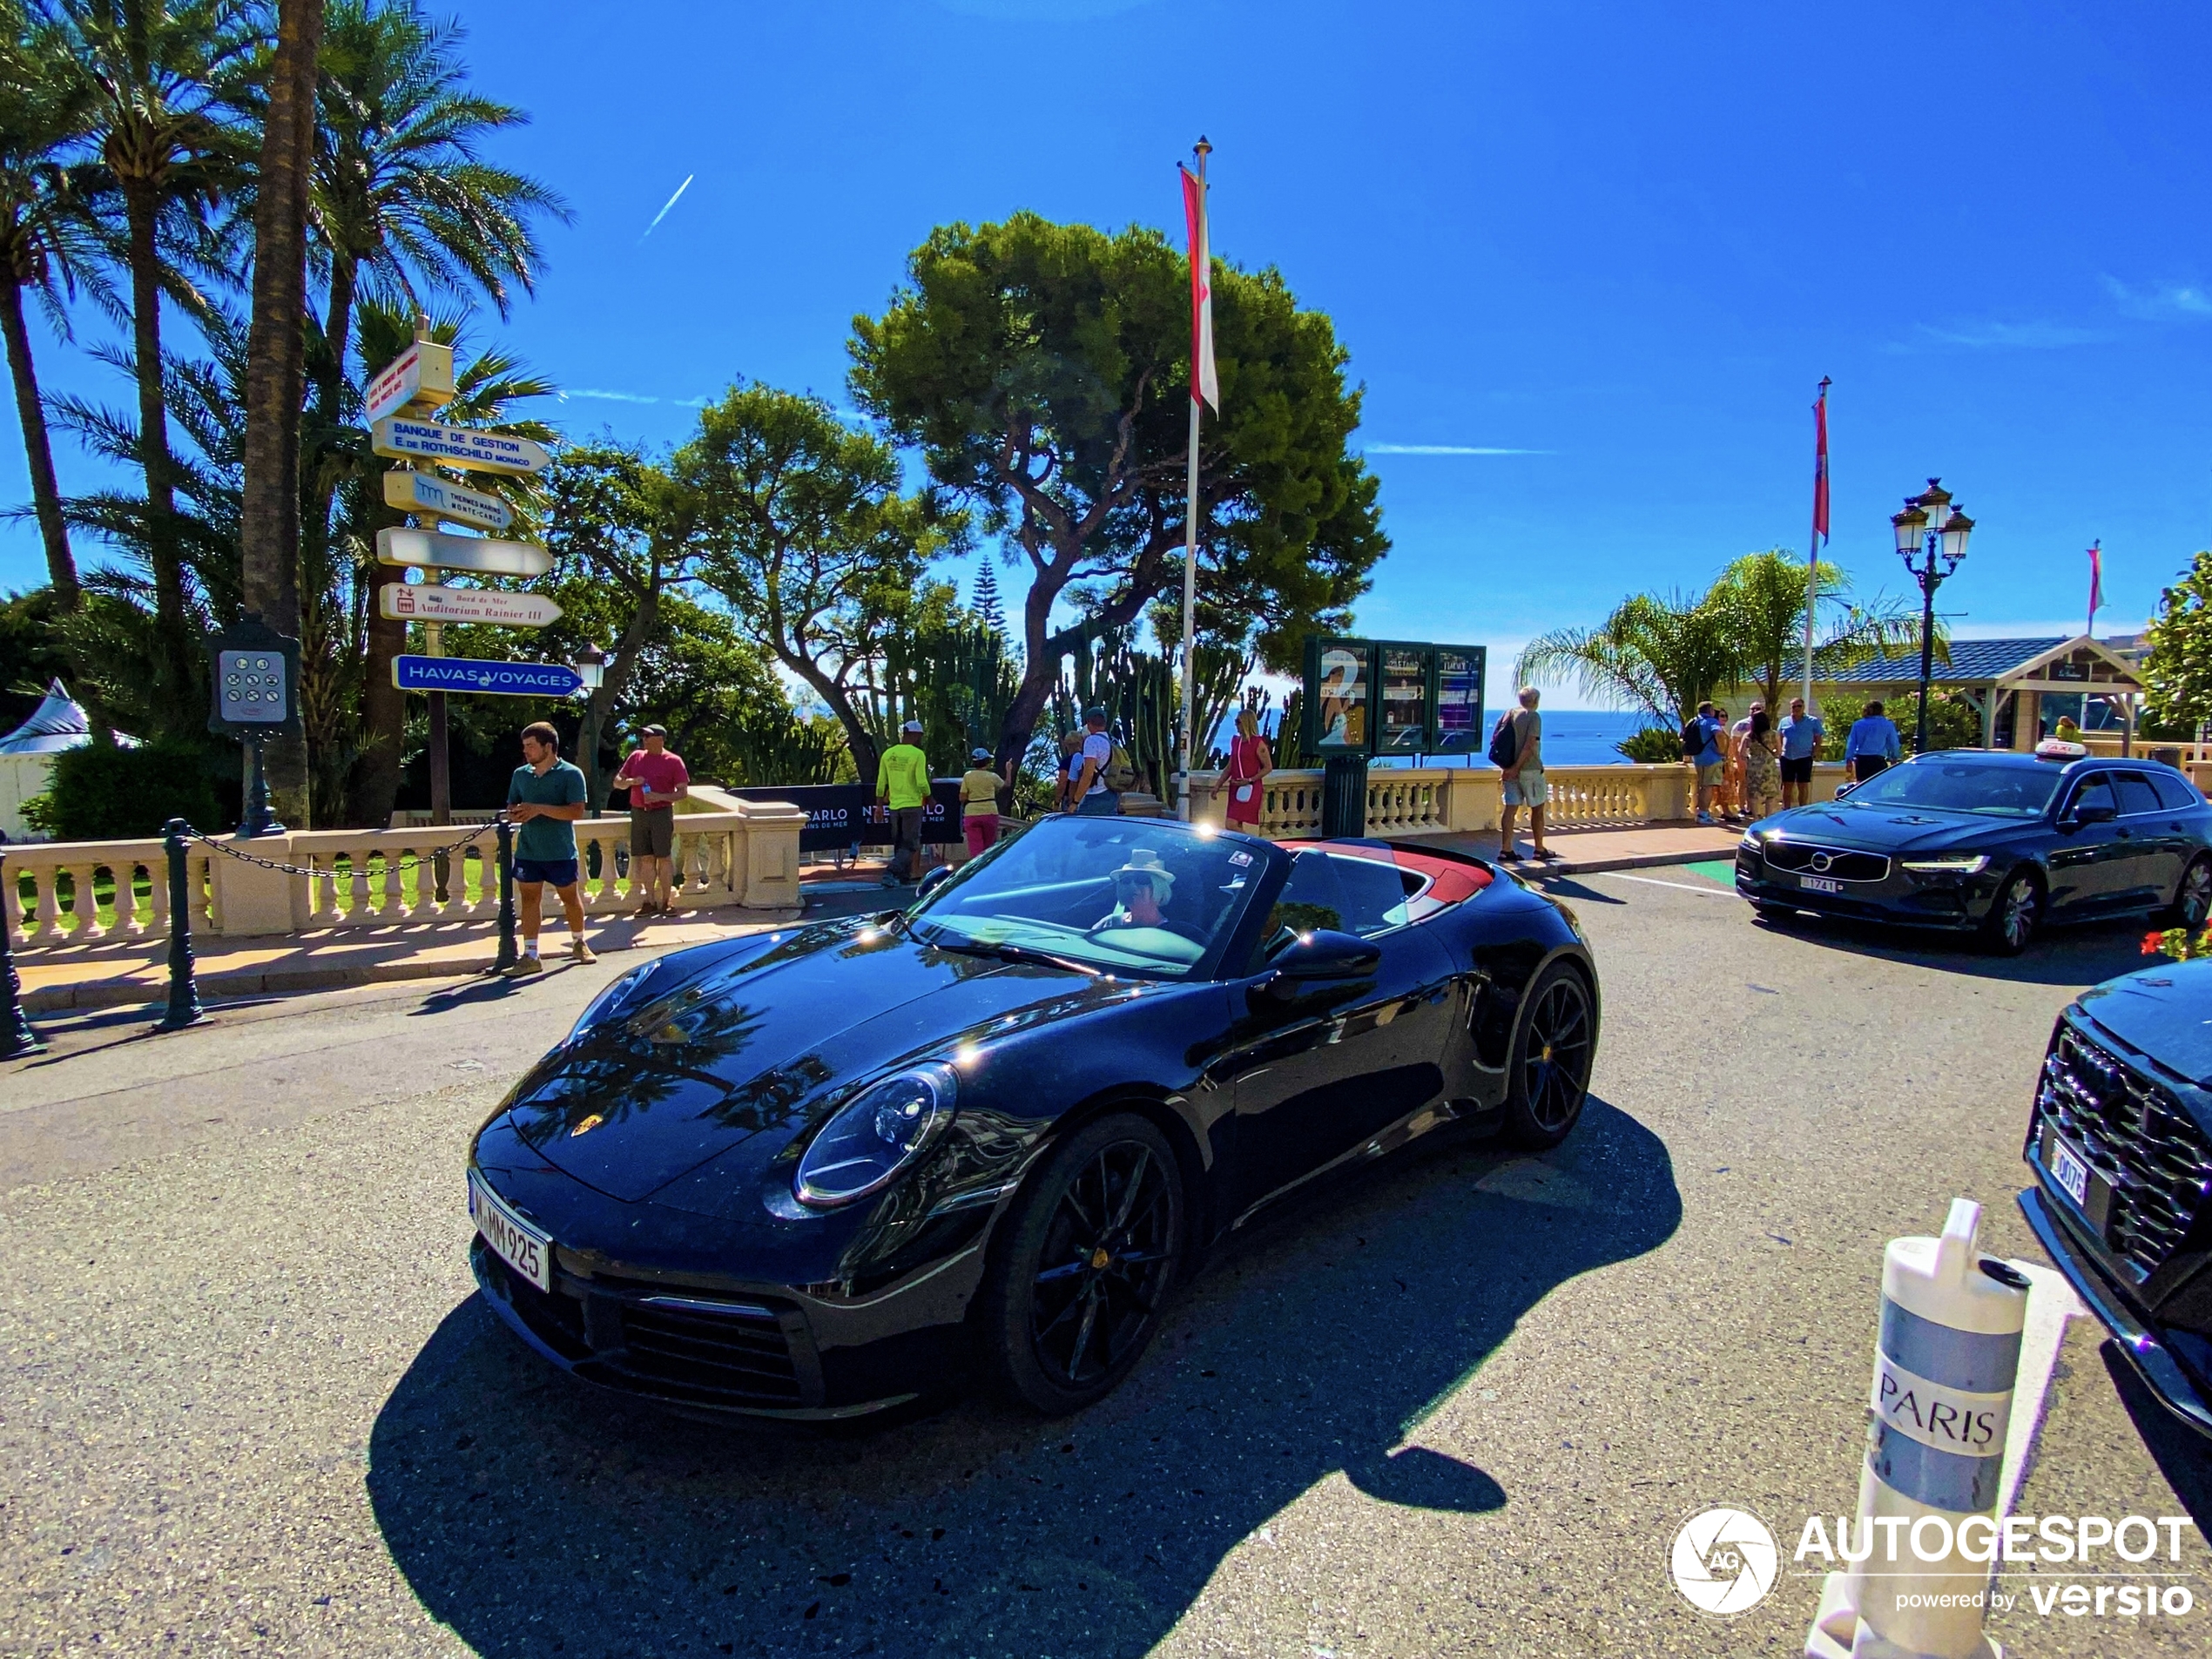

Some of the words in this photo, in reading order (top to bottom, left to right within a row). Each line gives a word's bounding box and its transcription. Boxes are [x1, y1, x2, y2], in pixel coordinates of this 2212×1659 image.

[394, 422, 443, 439] BANQUE
[450, 433, 466, 443] DE
[472, 436, 520, 453] GESTION
[407, 441, 418, 449] DE
[421, 442, 493, 461] ROTHSCHILD
[496, 455, 529, 467] MONACO
[450, 492, 479, 508] THERMES
[451, 502, 502, 523] MONTE-CARLO
[419, 604, 480, 616] Auditorium
[485, 608, 524, 619] Rainier
[528, 610, 542, 620] III
[409, 666, 478, 682] HAVAS
[485, 671, 572, 687] VOYAGES
[2046, 744, 2072, 752] TAXI
[488, 1206, 506, 1253] MM
[508, 1227, 539, 1278] 925
[1879, 1372, 1995, 1445] PARIS
